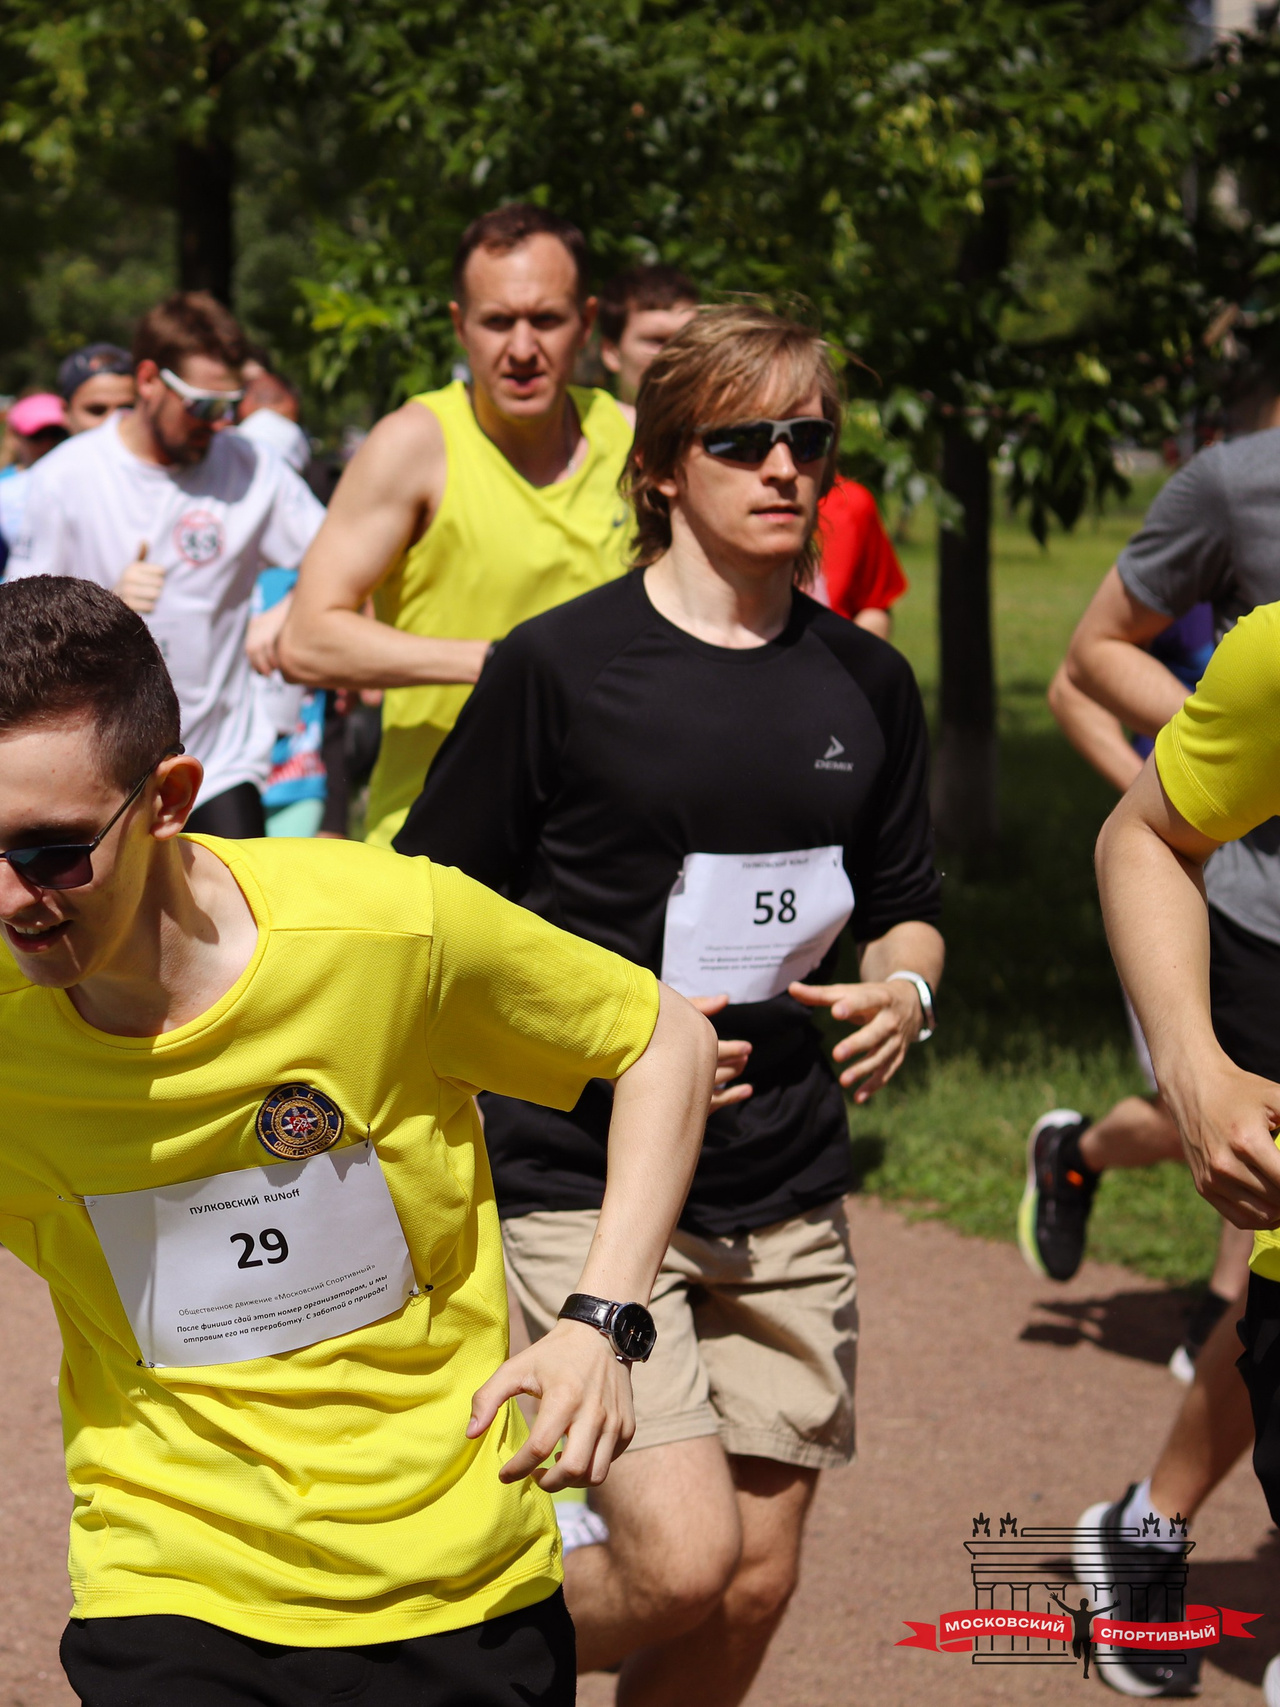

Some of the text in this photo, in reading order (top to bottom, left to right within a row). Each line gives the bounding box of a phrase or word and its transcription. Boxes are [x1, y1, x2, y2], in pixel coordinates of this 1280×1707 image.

[753, 888, 797, 925] 58
[189, 1188, 300, 1215] ПУЛКОВСКИЙ RUNoff
[229, 1228, 289, 1269] 29
[177, 1325, 199, 1333] После
[201, 1319, 233, 1331] финиша
[234, 1316, 252, 1324] сдай
[253, 1312, 275, 1321] этот
[277, 1305, 302, 1316] номер
[303, 1284, 368, 1309] организаторам,
[375, 1275, 388, 1283] мы
[178, 1303, 233, 1316] Общественное
[235, 1296, 272, 1309] движение
[326, 1264, 376, 1286] Спортивный»
[183, 1334, 224, 1344] отправим
[251, 1316, 305, 1332] переработку.
[313, 1301, 347, 1318] заботой
[354, 1284, 388, 1303] природе!
